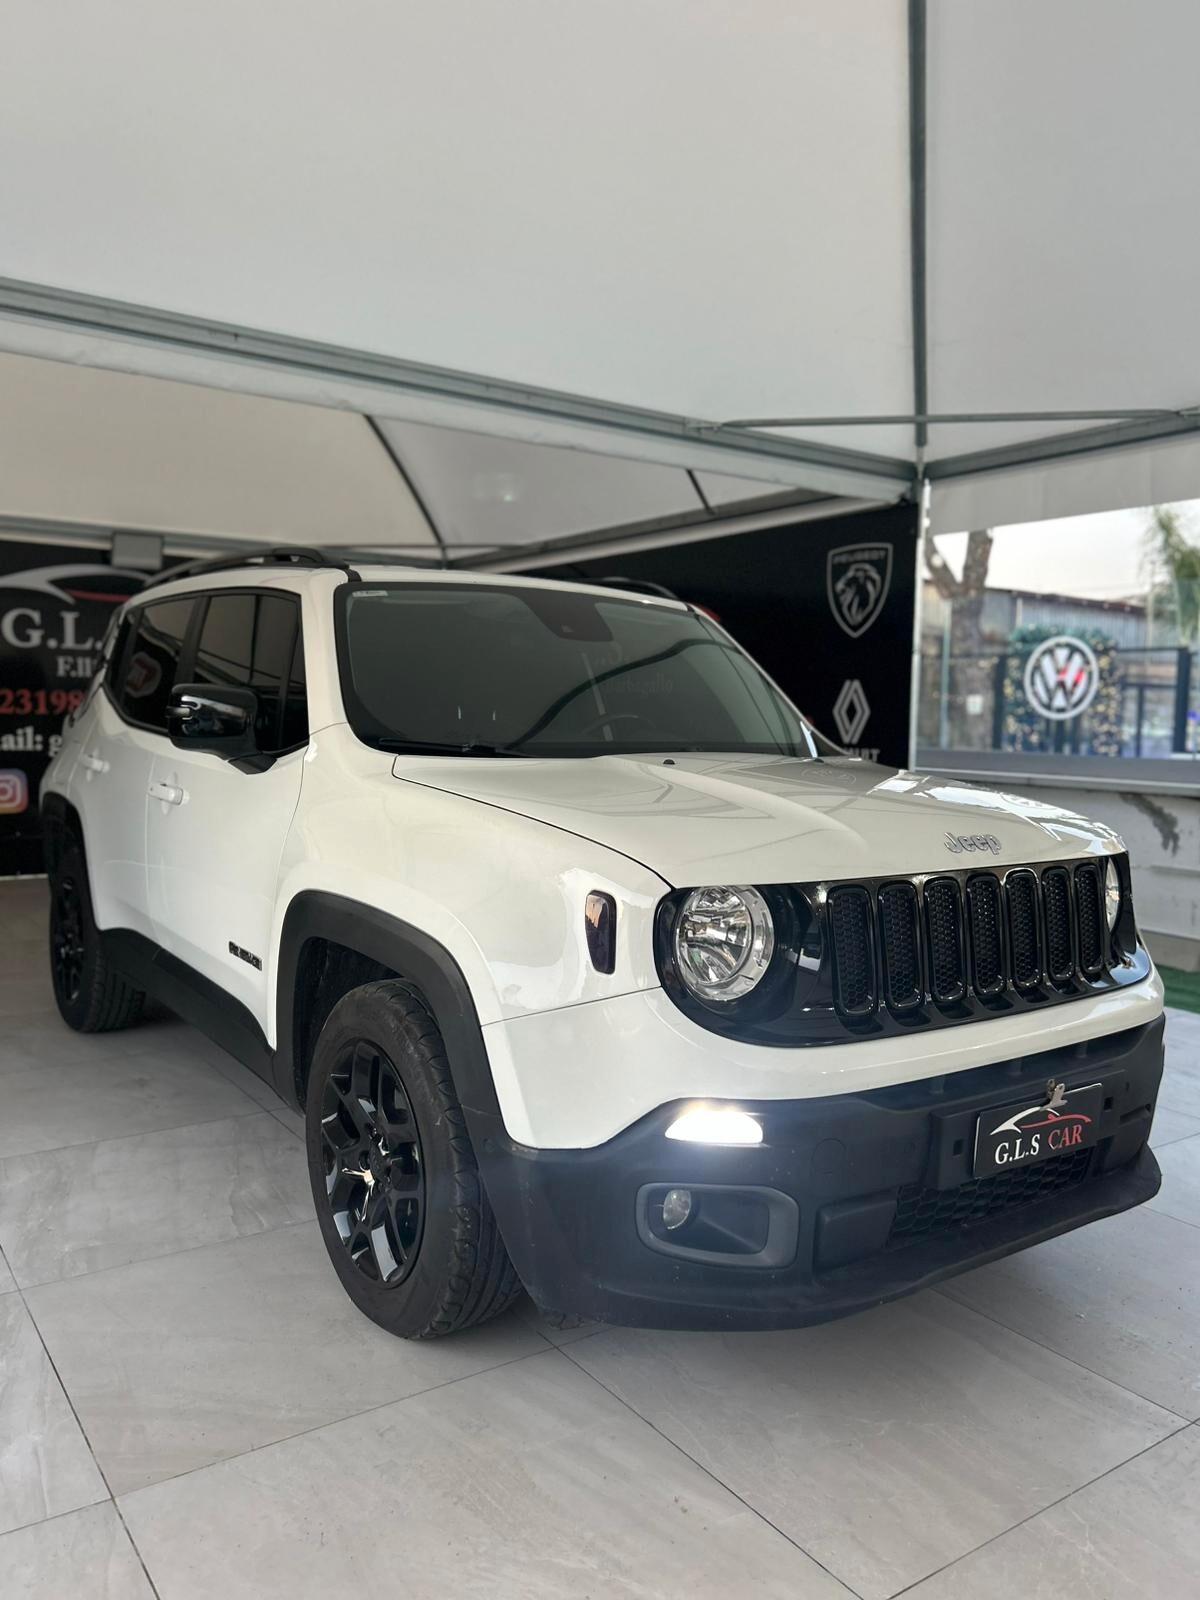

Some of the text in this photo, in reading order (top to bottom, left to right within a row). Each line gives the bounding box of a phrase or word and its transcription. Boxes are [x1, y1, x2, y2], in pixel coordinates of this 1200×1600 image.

[944, 832, 1001, 855] Jeep
[995, 1124, 1082, 1165] G.L.S CAR
